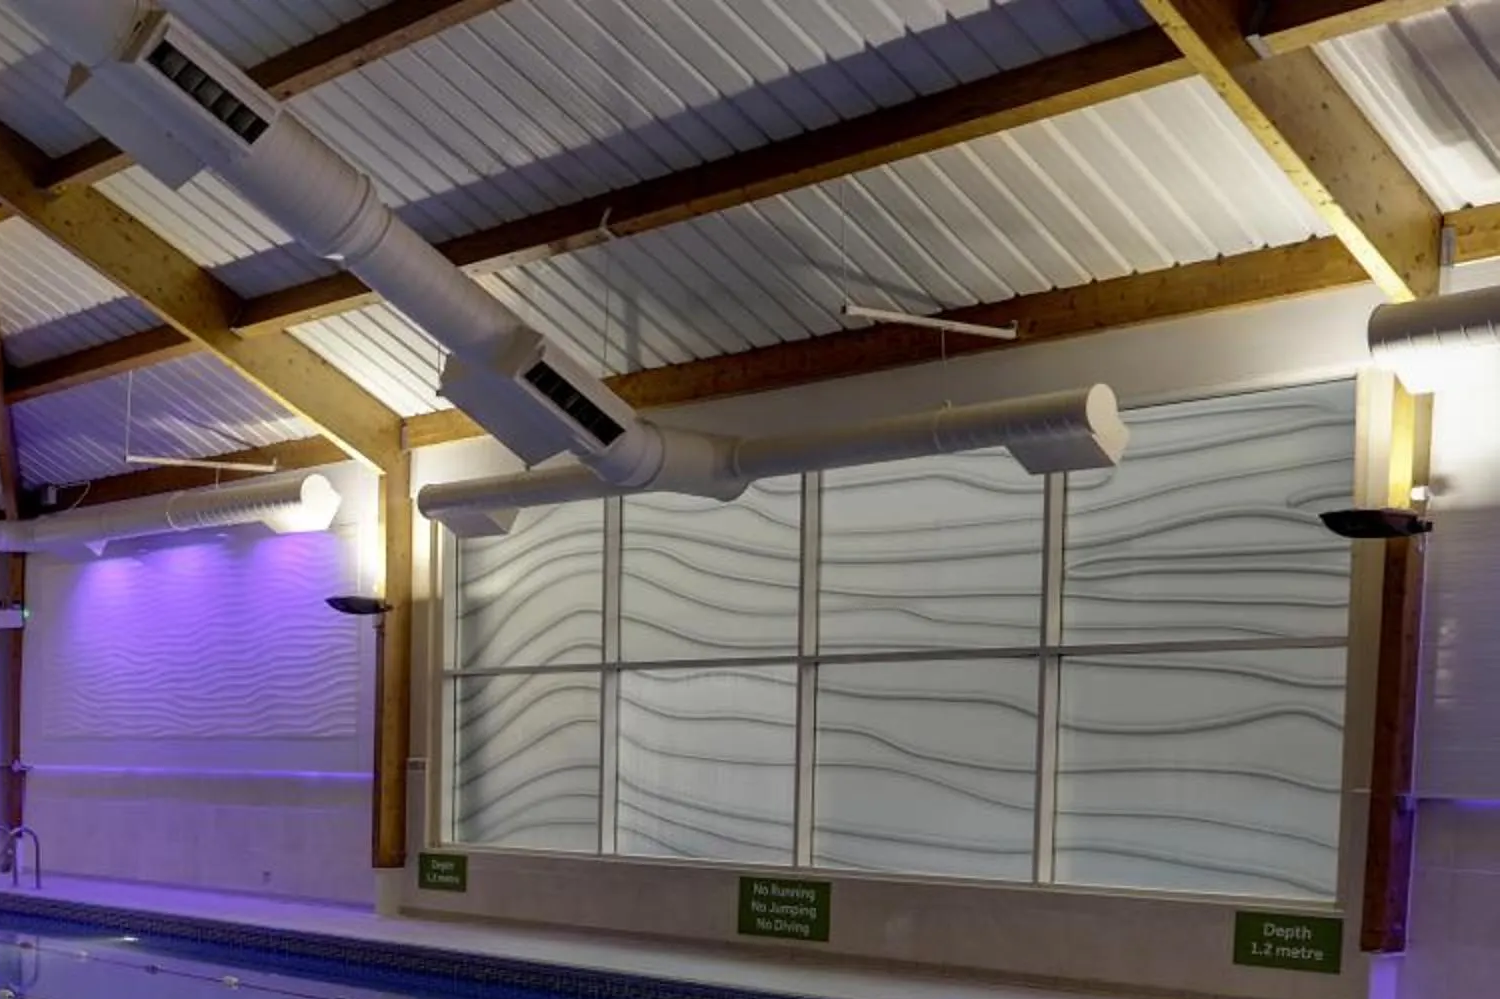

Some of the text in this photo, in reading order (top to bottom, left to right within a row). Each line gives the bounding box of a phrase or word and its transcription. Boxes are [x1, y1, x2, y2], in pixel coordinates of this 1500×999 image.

[753, 883, 815, 902] No Running
[752, 900, 817, 919] No Jumping
[756, 918, 809, 936] No Diving
[1263, 923, 1312, 940] Depth
[1251, 942, 1323, 960] 1.2 metre
